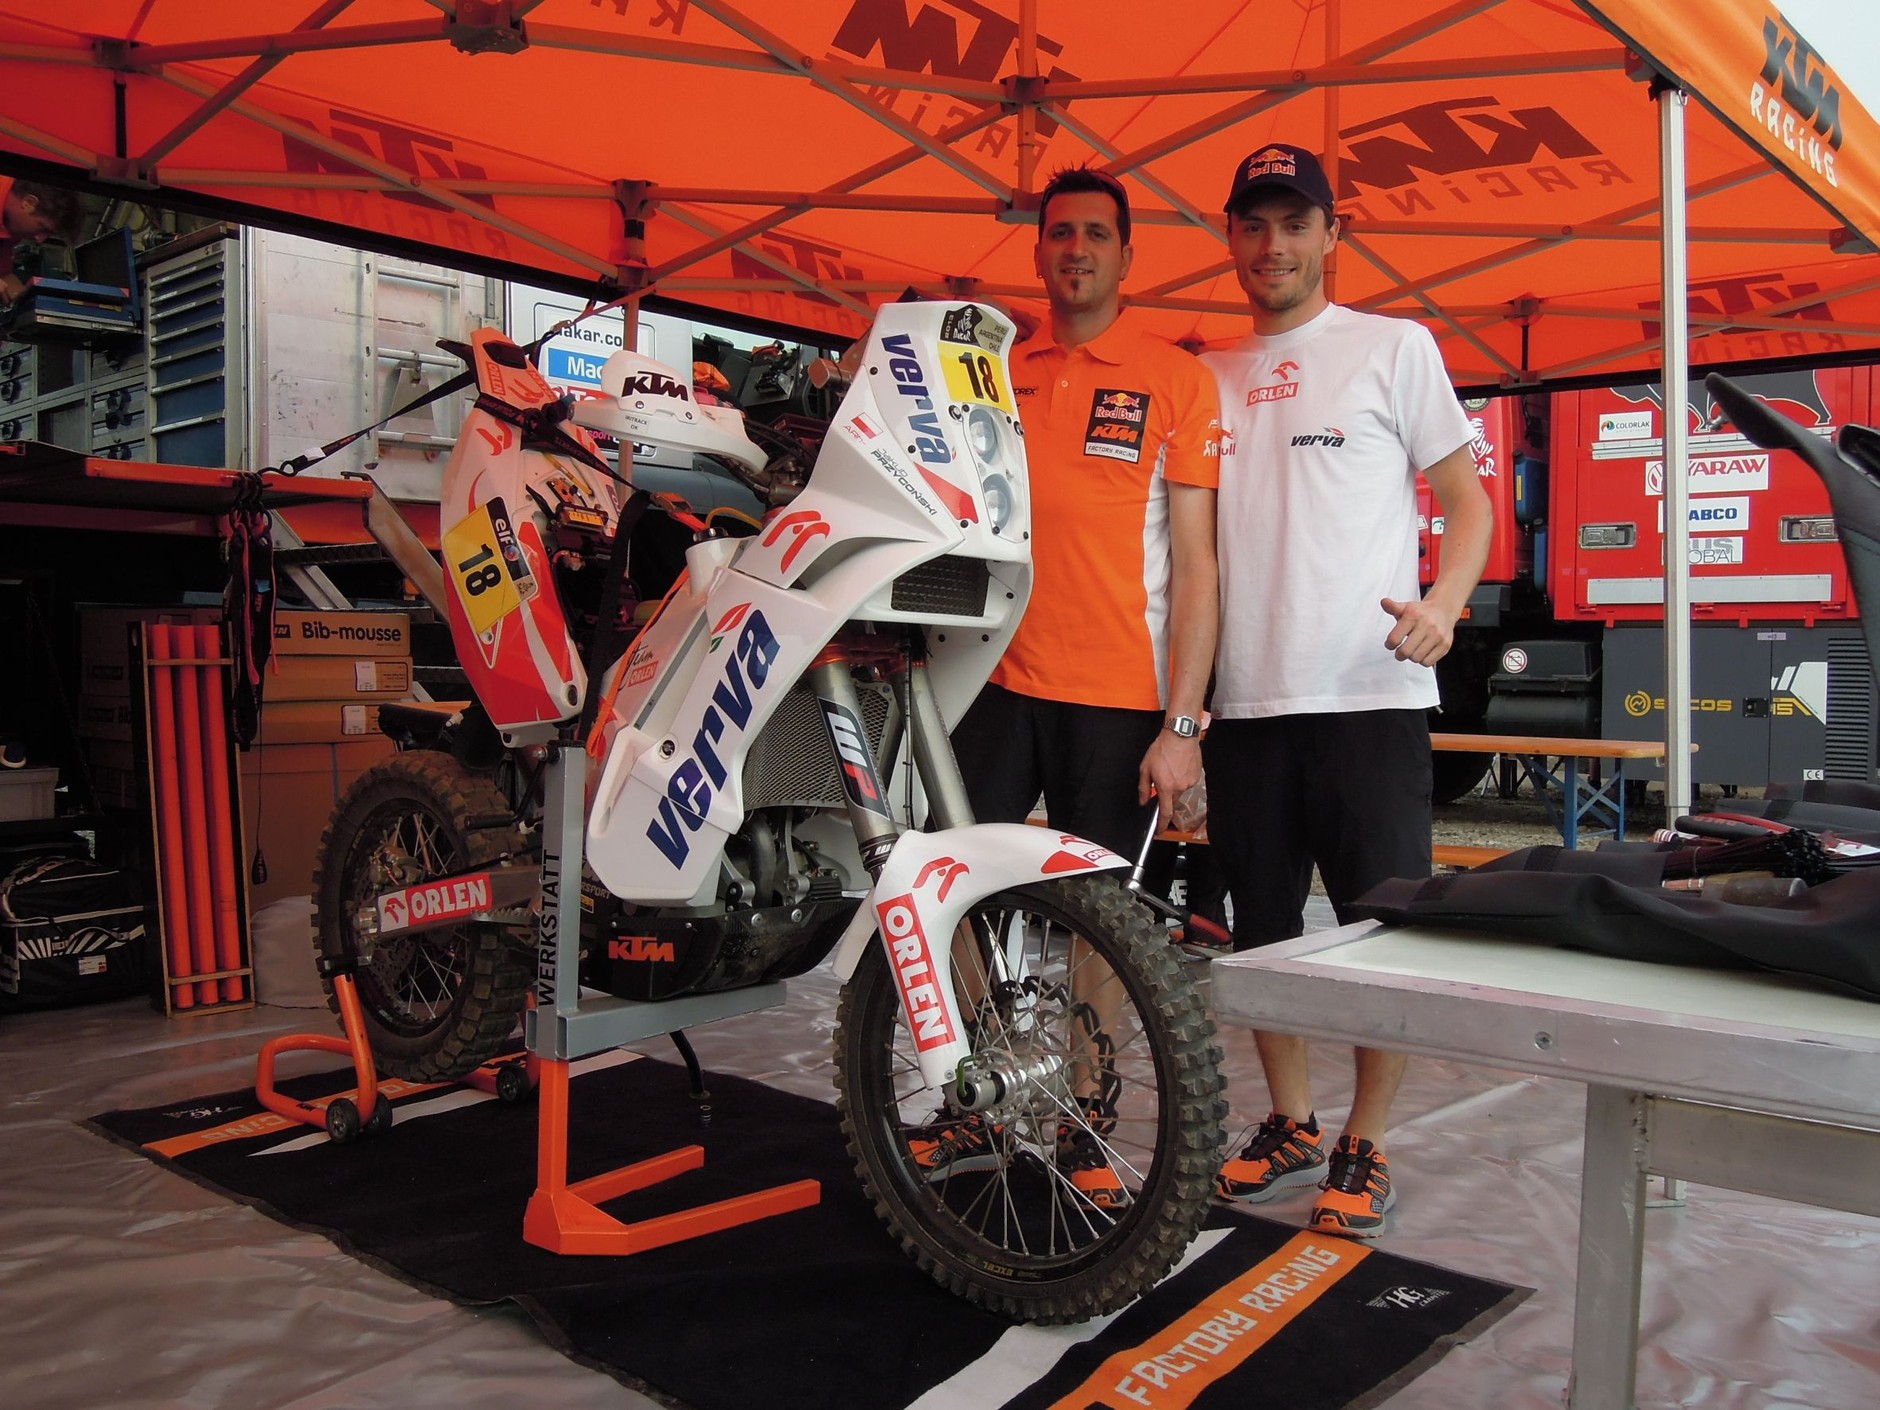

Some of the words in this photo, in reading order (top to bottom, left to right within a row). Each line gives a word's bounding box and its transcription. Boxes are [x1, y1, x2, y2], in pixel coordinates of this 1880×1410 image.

[1760, 13, 1843, 152] KTM
[1248, 162, 1270, 180] Red
[1272, 162, 1296, 176] Bull
[559, 323, 624, 348] akar.co
[621, 371, 689, 401] KTM
[958, 351, 1000, 403] 18
[881, 333, 952, 464] verva
[1014, 388, 1036, 396] OREX
[1249, 383, 1295, 403] ORLEN
[1095, 406, 1119, 419] Red
[1118, 408, 1142, 422] Bull
[1615, 421, 1650, 429] COLORLAK
[1091, 423, 1138, 443] KTM
[1291, 434, 1345, 448] verva
[1219, 442, 1236, 456] ull
[1688, 508, 1737, 521] ABCO
[1688, 549, 1741, 564] OBAL
[458, 543, 502, 597] 18
[302, 621, 402, 642] Bib-mousse
[1654, 698, 1732, 711] SCOS
[646, 609, 781, 871] verva
[827, 711, 879, 801] WP
[411, 879, 487, 919] ORLEN
[581, 881, 611, 900] RSPORT
[538, 849, 560, 1006] WERKSTATT
[608, 935, 675, 962] KTM
[885, 905, 948, 1042] ORLEN
[1114, 1308, 1258, 1406] FACTORY
